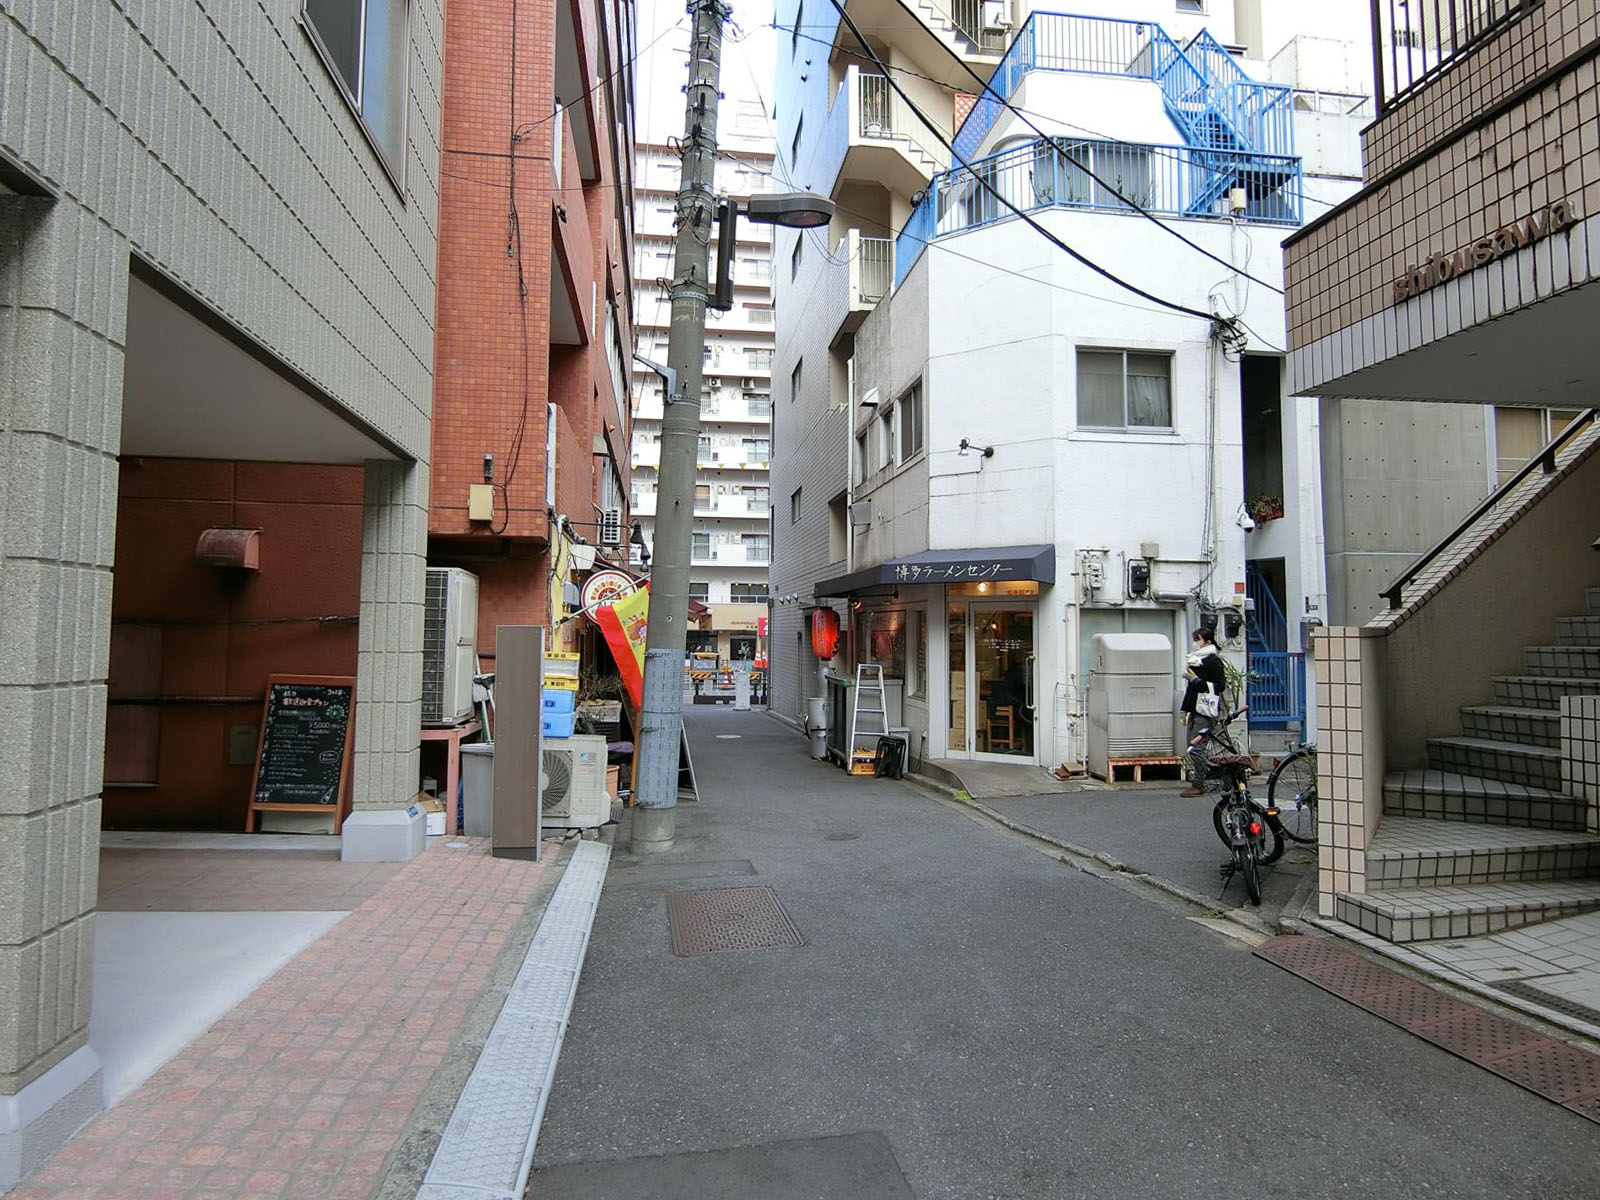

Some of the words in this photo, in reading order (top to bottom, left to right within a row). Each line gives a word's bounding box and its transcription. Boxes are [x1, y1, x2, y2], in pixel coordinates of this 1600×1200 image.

[1393, 200, 1580, 302] shibusawa
[895, 563, 1013, 581] 博多ラーメンセンター
